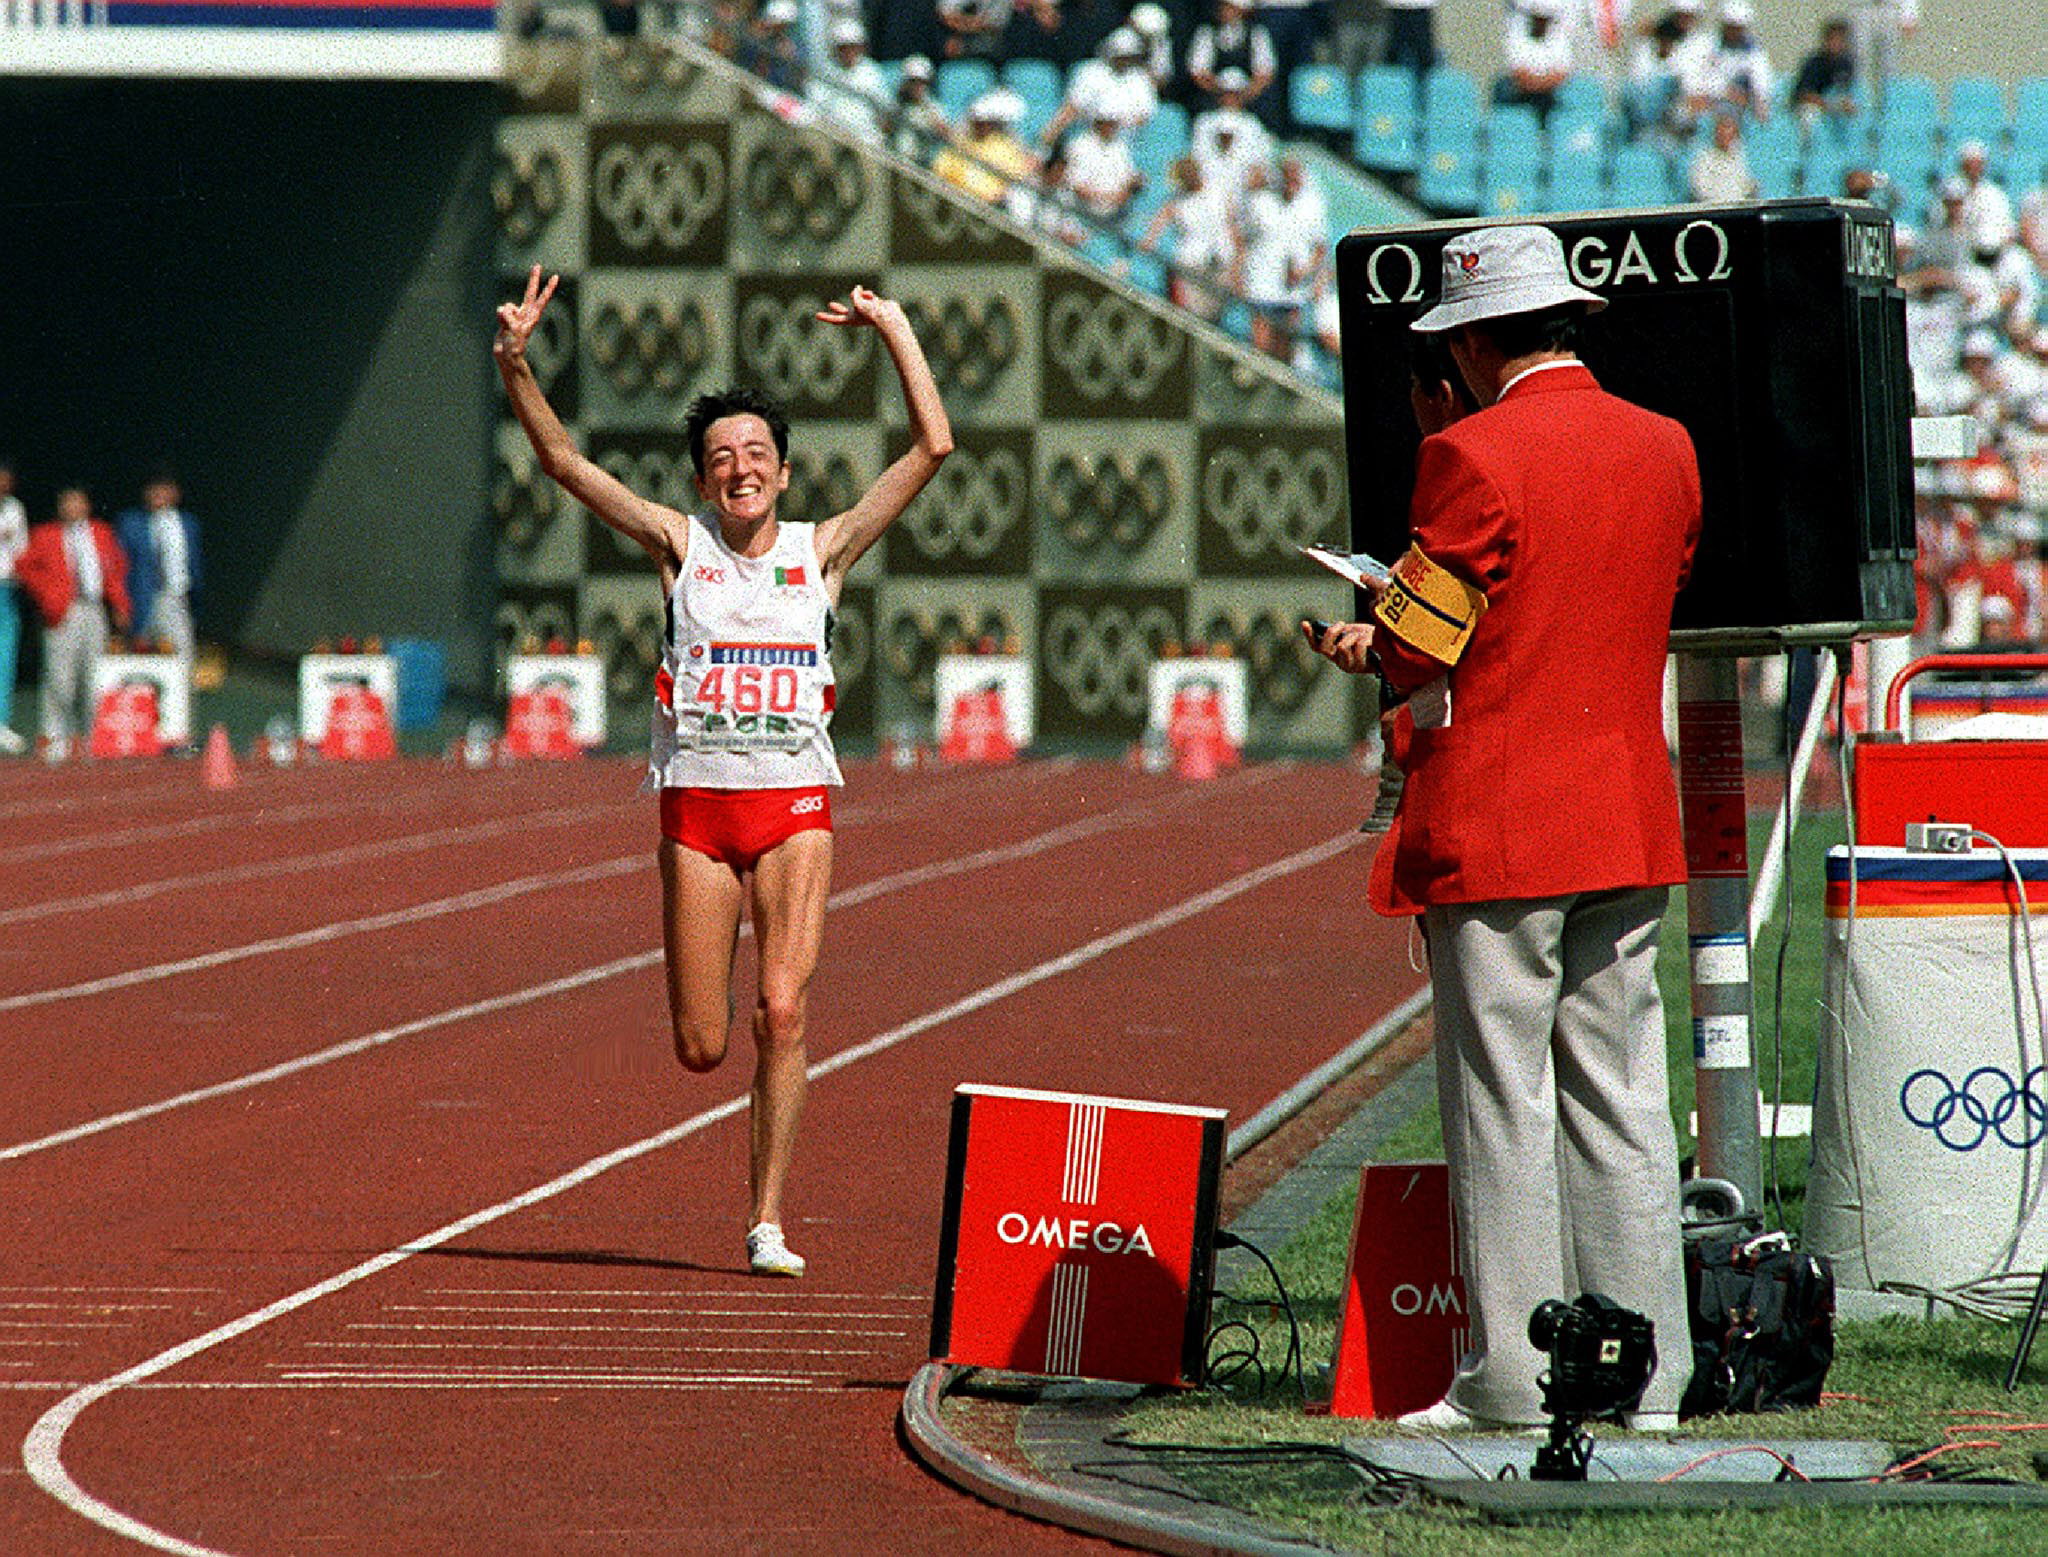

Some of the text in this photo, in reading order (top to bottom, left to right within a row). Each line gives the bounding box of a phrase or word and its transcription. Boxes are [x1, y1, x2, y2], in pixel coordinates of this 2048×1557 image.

[1570, 229, 1658, 288] GA
[695, 666, 798, 713] 460
[996, 1212, 1156, 1258] OMEGA
[1391, 1282, 1463, 1316] OM
